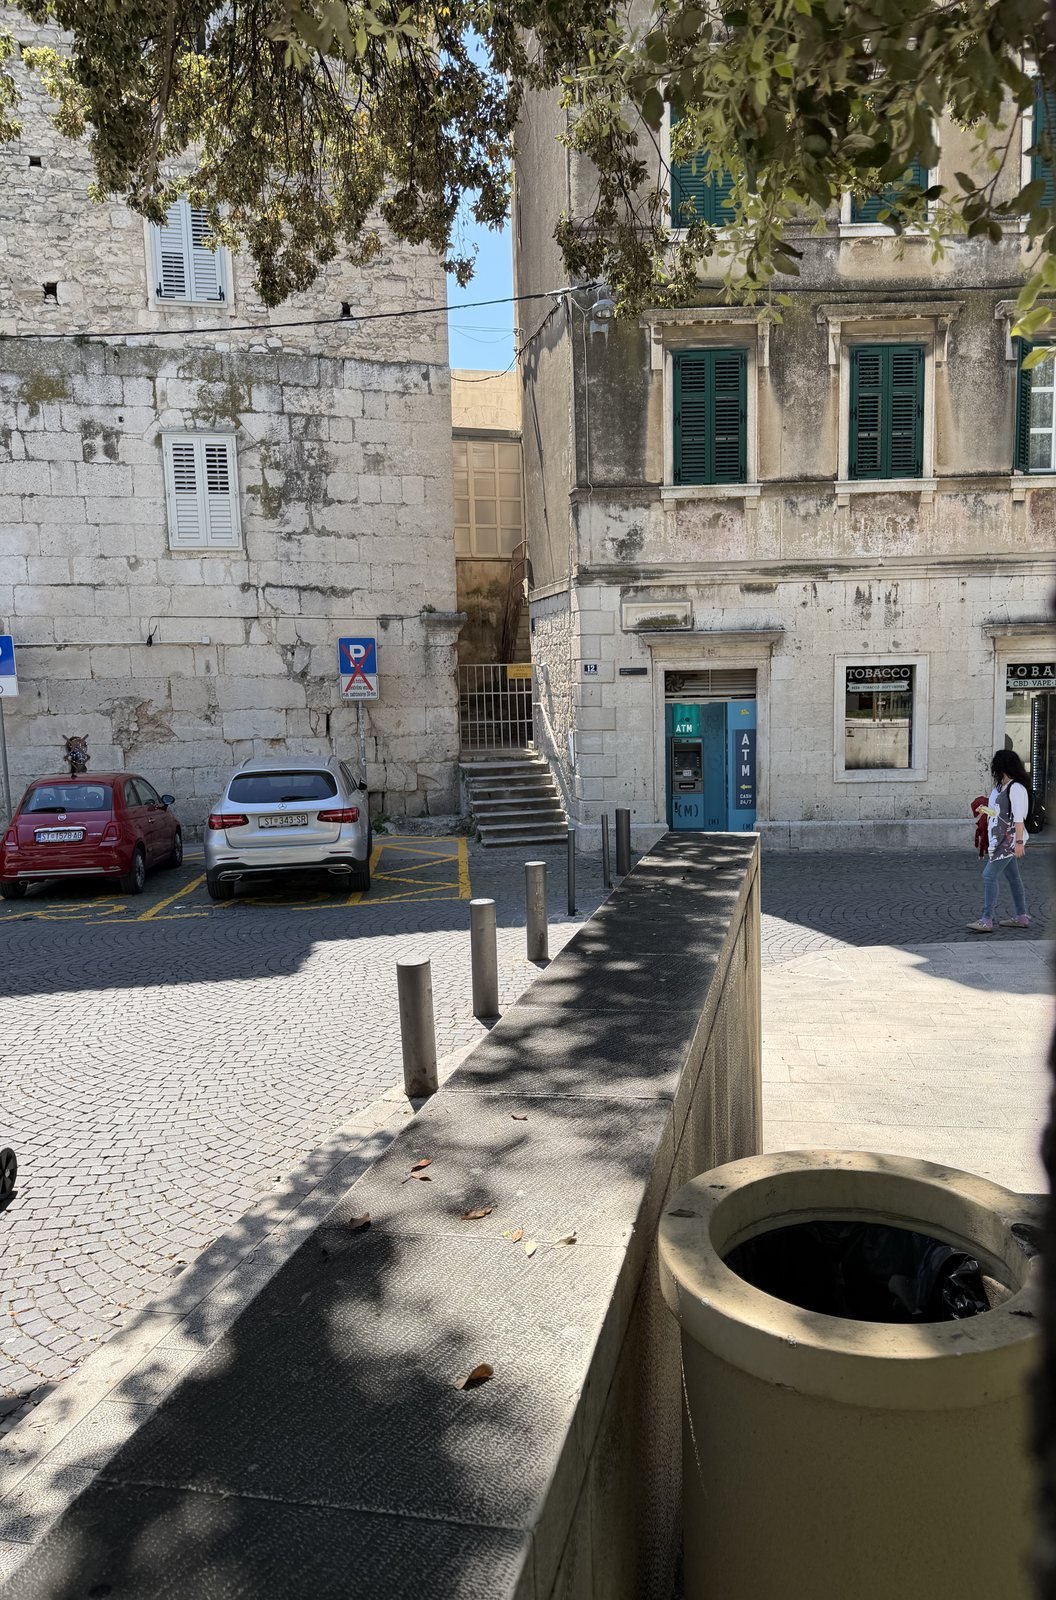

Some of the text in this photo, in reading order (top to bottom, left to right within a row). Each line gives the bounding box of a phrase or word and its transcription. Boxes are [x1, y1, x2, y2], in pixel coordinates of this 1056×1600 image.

[587, 664, 596, 672] 12
[846, 667, 911, 679] TOBACCO
[675, 724, 693, 733] ATM
[741, 733, 750, 777] ATM
[264, 817, 273, 826] ST
